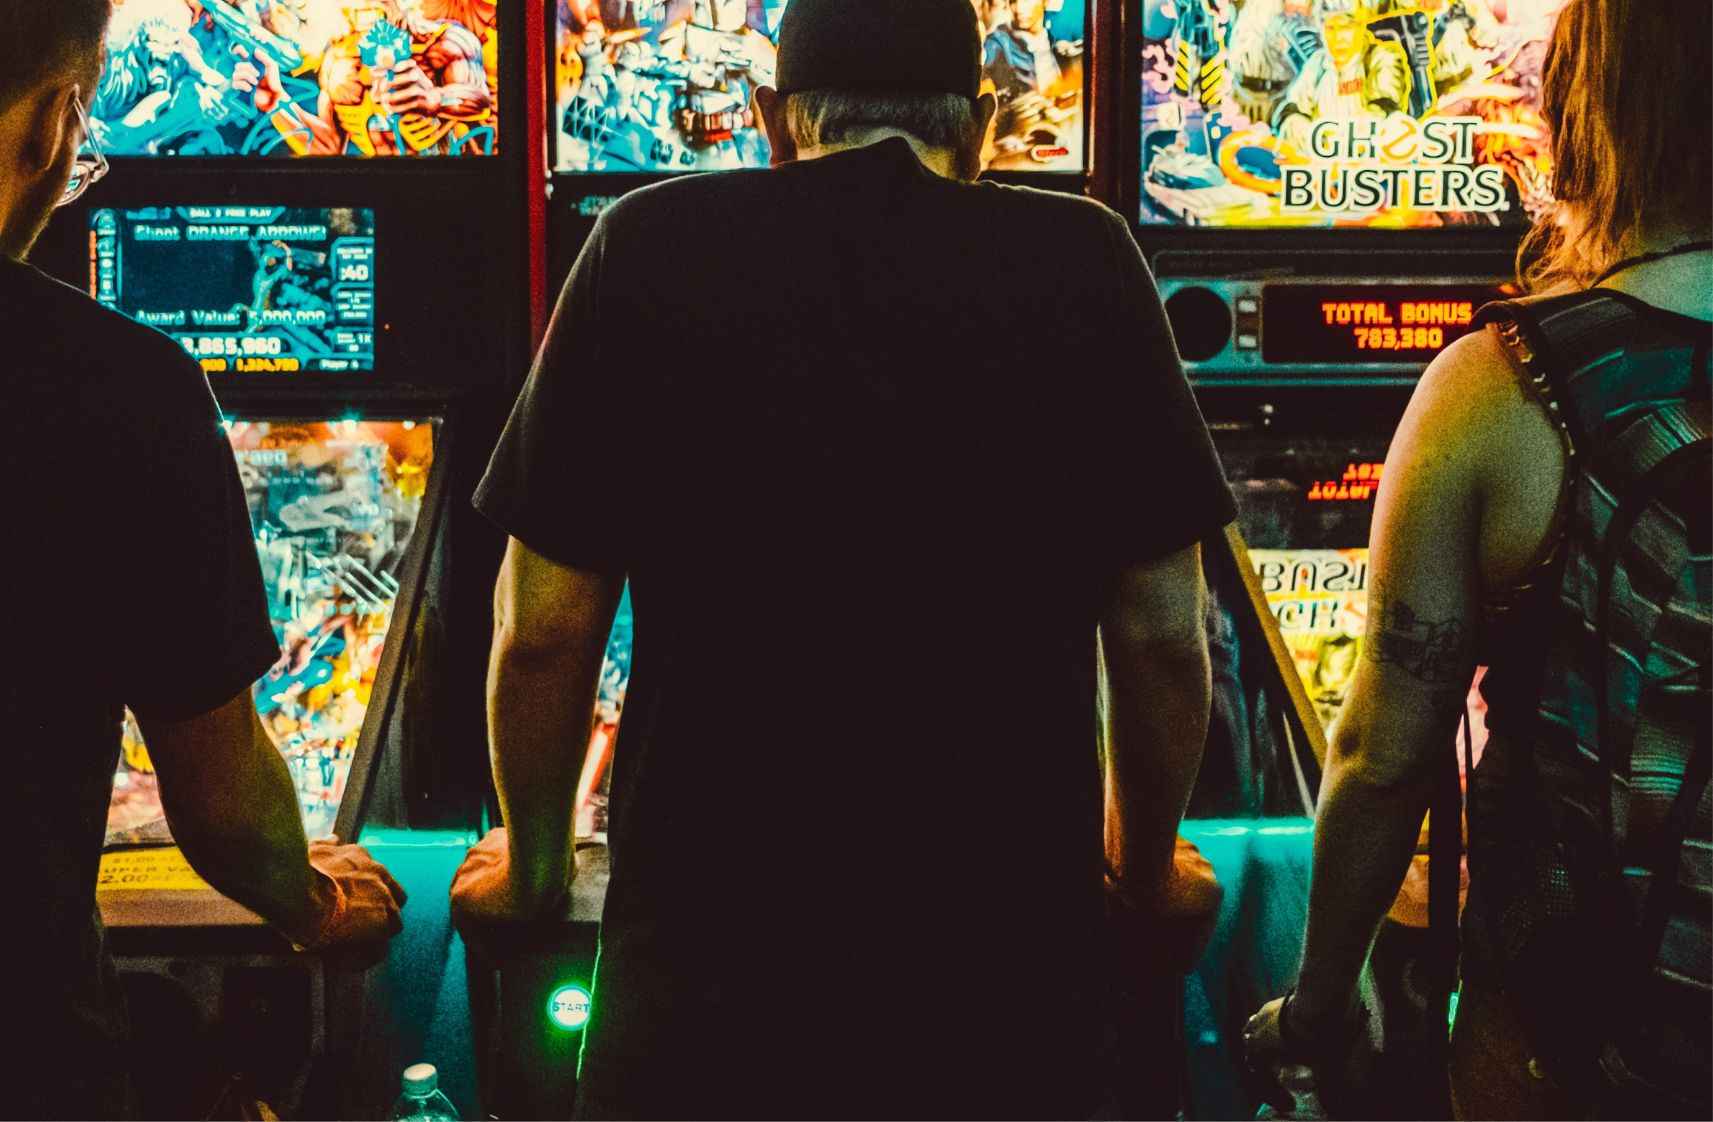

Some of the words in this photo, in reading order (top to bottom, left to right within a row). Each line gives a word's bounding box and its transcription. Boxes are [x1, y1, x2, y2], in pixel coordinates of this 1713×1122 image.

[1284, 168, 1502, 208] BUSTERS
[250, 207, 272, 218] PLAY
[187, 225, 249, 240] ORANGE
[137, 309, 185, 325] Award
[192, 309, 241, 325] Value:
[1322, 302, 1393, 325] TOTAL
[1401, 302, 1473, 325] BONUS
[1354, 328, 1443, 350] 783,380
[551, 1001, 591, 1013] START
